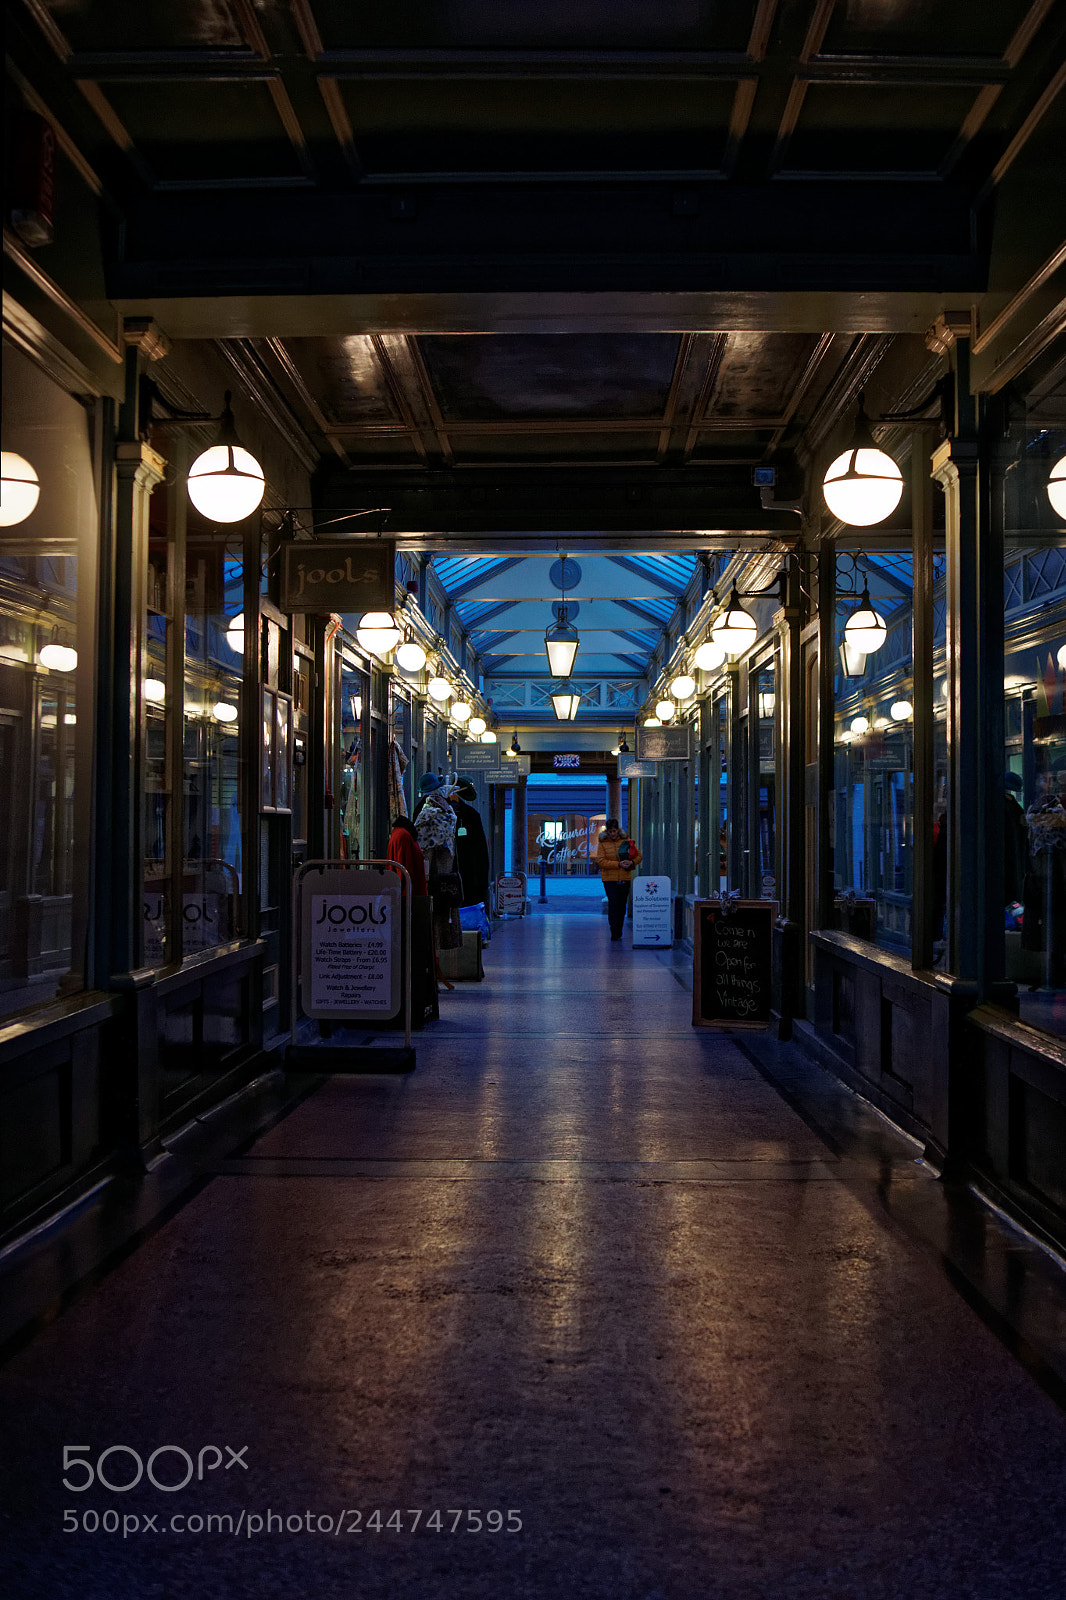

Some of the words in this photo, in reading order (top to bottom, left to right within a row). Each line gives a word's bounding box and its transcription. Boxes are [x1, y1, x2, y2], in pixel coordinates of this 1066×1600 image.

[296, 556, 379, 597] jools
[316, 899, 387, 925] jools
[715, 920, 744, 937] Come
[717, 939, 731, 948] we
[733, 940, 748, 949] are
[333, 956, 351, 964] Straps
[715, 950, 742, 970] Open
[743, 955, 757, 974] for
[716, 973, 729, 985] all
[731, 974, 760, 994] things
[716, 990, 759, 1016] Vintage
